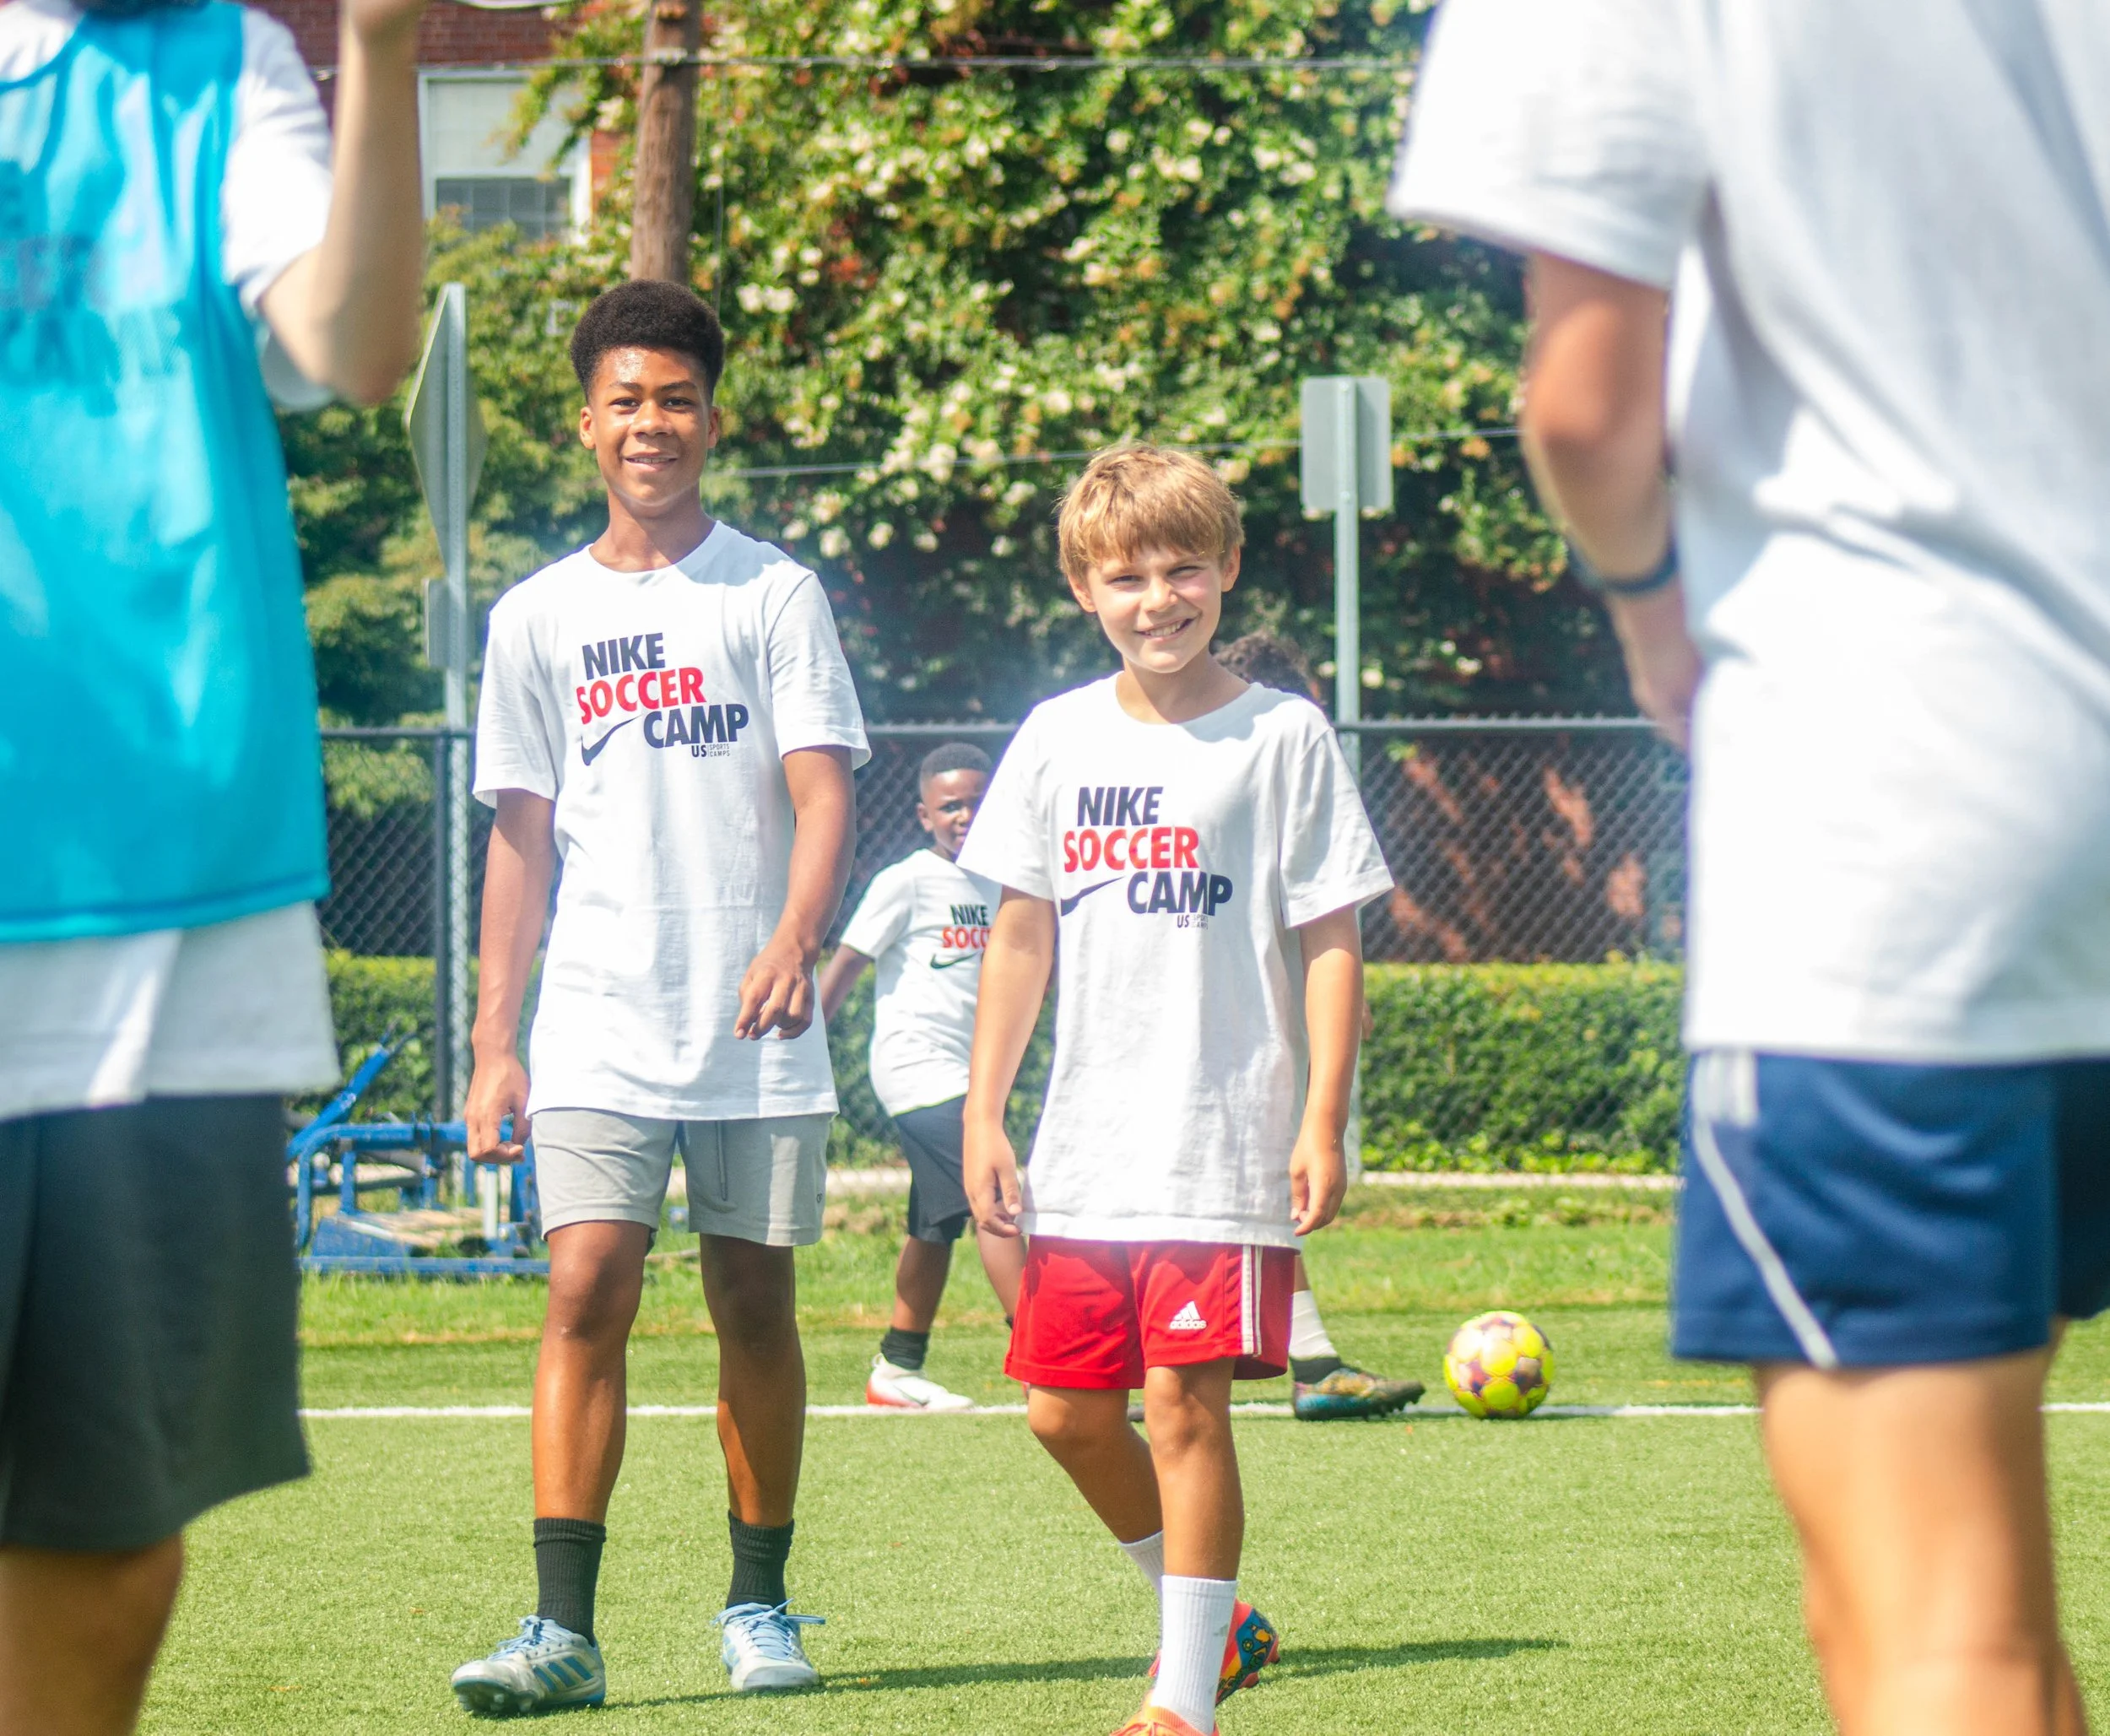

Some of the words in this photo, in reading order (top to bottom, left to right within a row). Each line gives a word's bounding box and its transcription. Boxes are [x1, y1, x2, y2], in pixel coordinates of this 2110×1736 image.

[582, 632, 666, 681] NIKE
[576, 667, 707, 725] SOCCER
[643, 704, 749, 749] CAMP
[709, 743, 730, 751] SPORTS
[691, 744, 707, 758] US
[710, 749, 731, 758] CAMPS
[1077, 786, 1164, 827] NIKE
[1063, 826, 1200, 873] SOCCER
[1128, 871, 1234, 917] CAMP
[950, 904, 989, 926] NIKE
[1177, 914, 1190, 928] US
